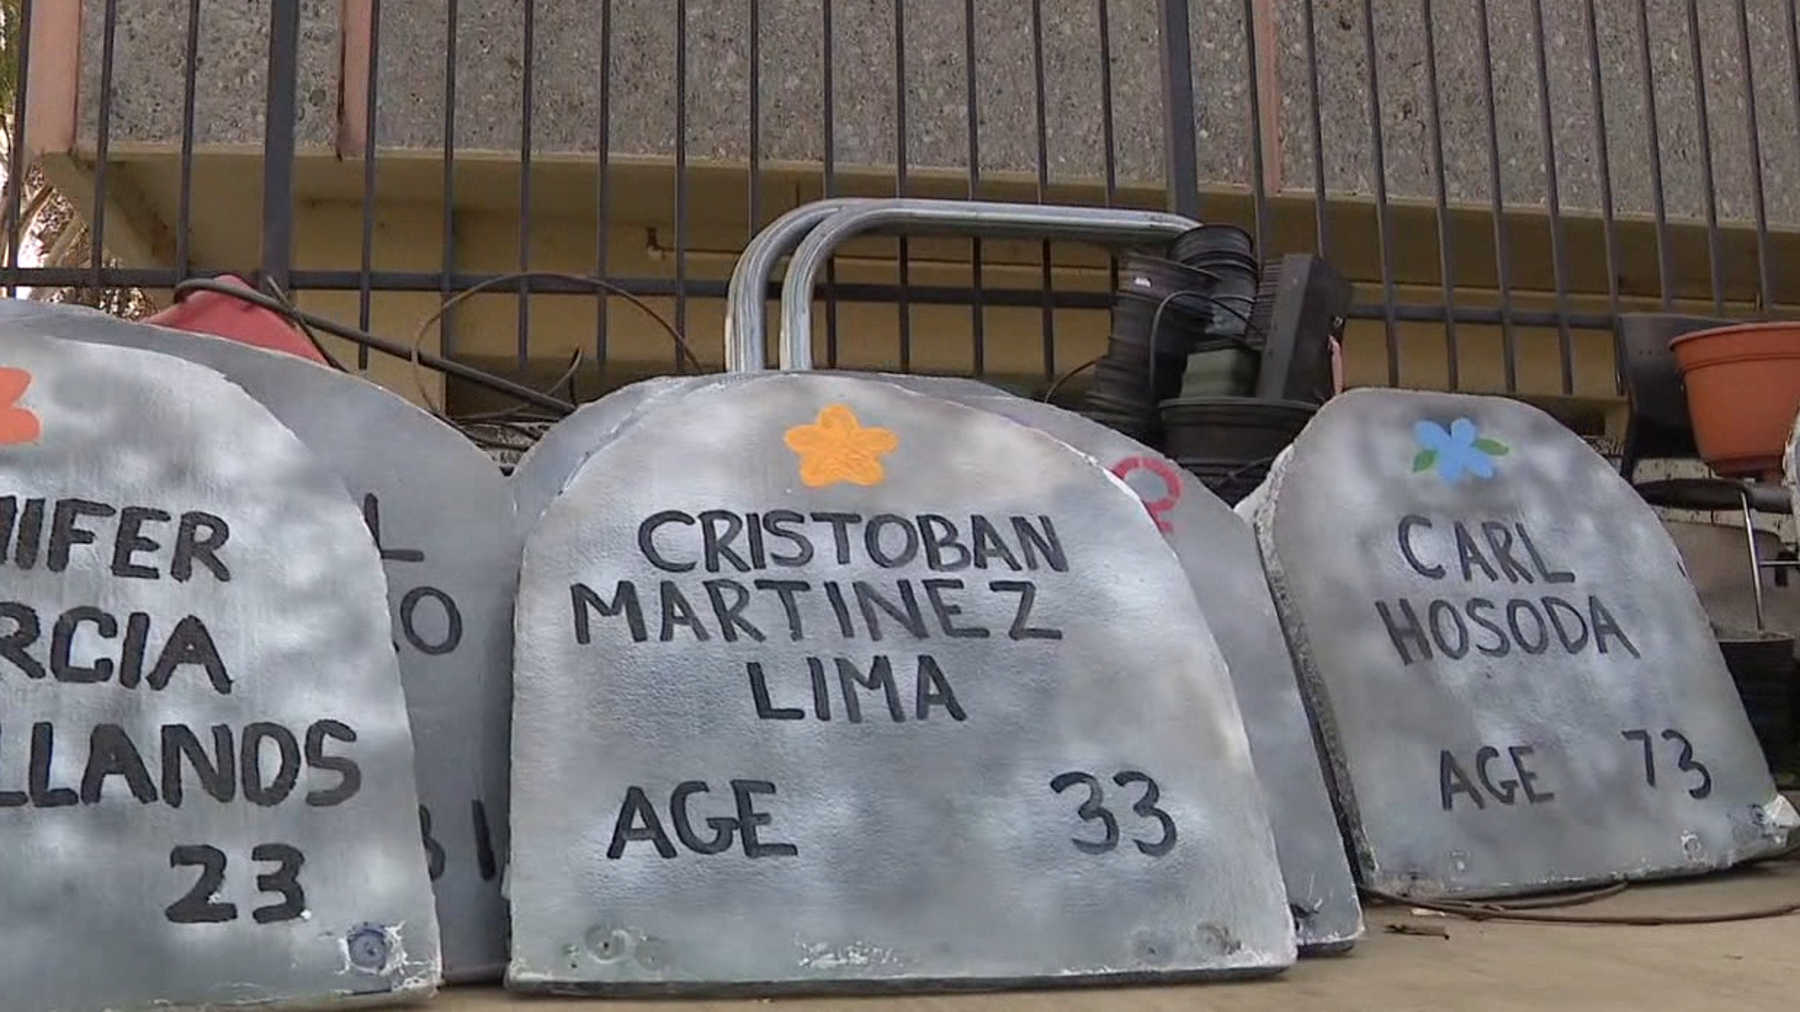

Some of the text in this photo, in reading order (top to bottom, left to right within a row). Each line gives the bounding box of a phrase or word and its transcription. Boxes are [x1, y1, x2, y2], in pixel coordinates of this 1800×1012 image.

[637, 510, 1069, 574] CRISTOBAN
[1397, 514, 1576, 585] CARL
[570, 580, 1063, 645] MARTINEZ
[1375, 594, 1641, 666] HOSODA
[746, 655, 968, 724] LIMA
[1438, 729, 1712, 811] AGE 73
[606, 770, 1178, 859] AGE 33
[165, 843, 312, 924] 23
